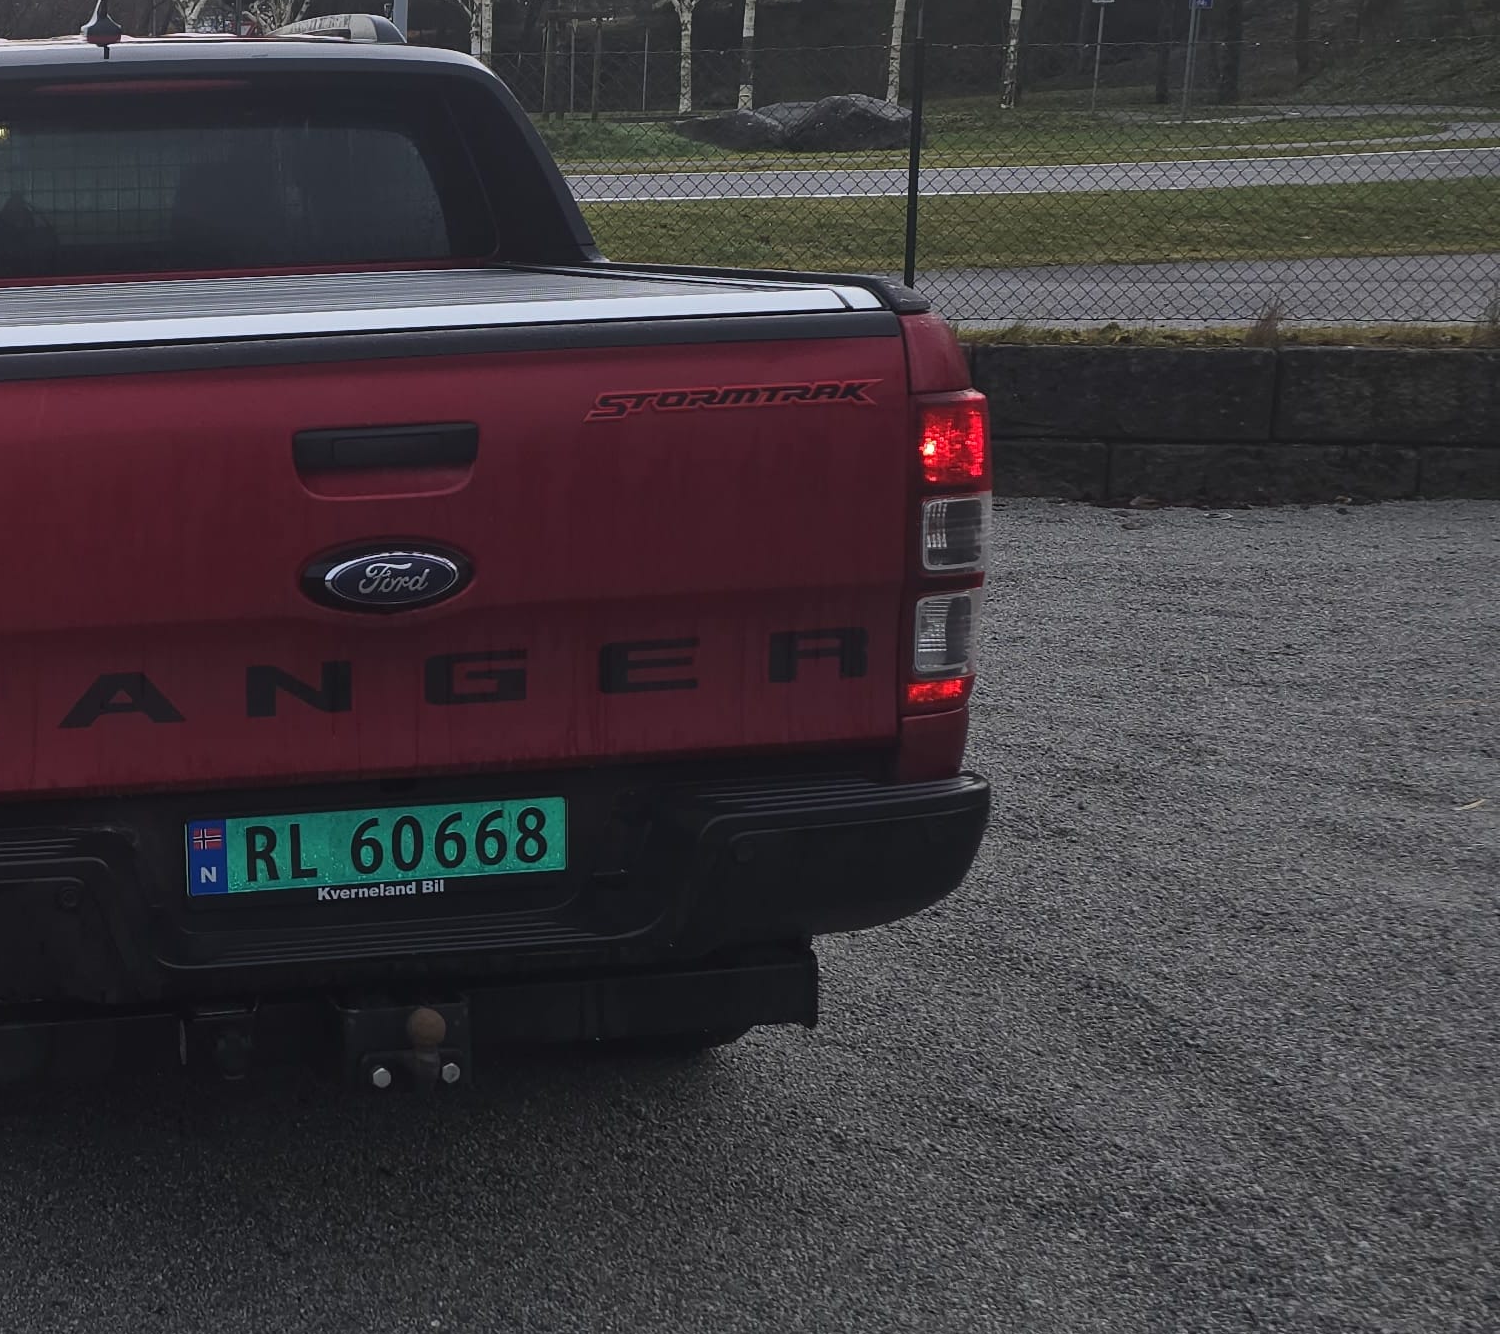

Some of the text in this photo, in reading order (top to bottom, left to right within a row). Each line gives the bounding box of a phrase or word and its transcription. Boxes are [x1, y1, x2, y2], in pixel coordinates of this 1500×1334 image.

[585, 379, 880, 421] STORMTRAK
[358, 562, 431, 594] Ford
[245, 806, 549, 883] RL 60668
[200, 867, 217, 883] N
[317, 879, 445, 901] Kverneland Bil
